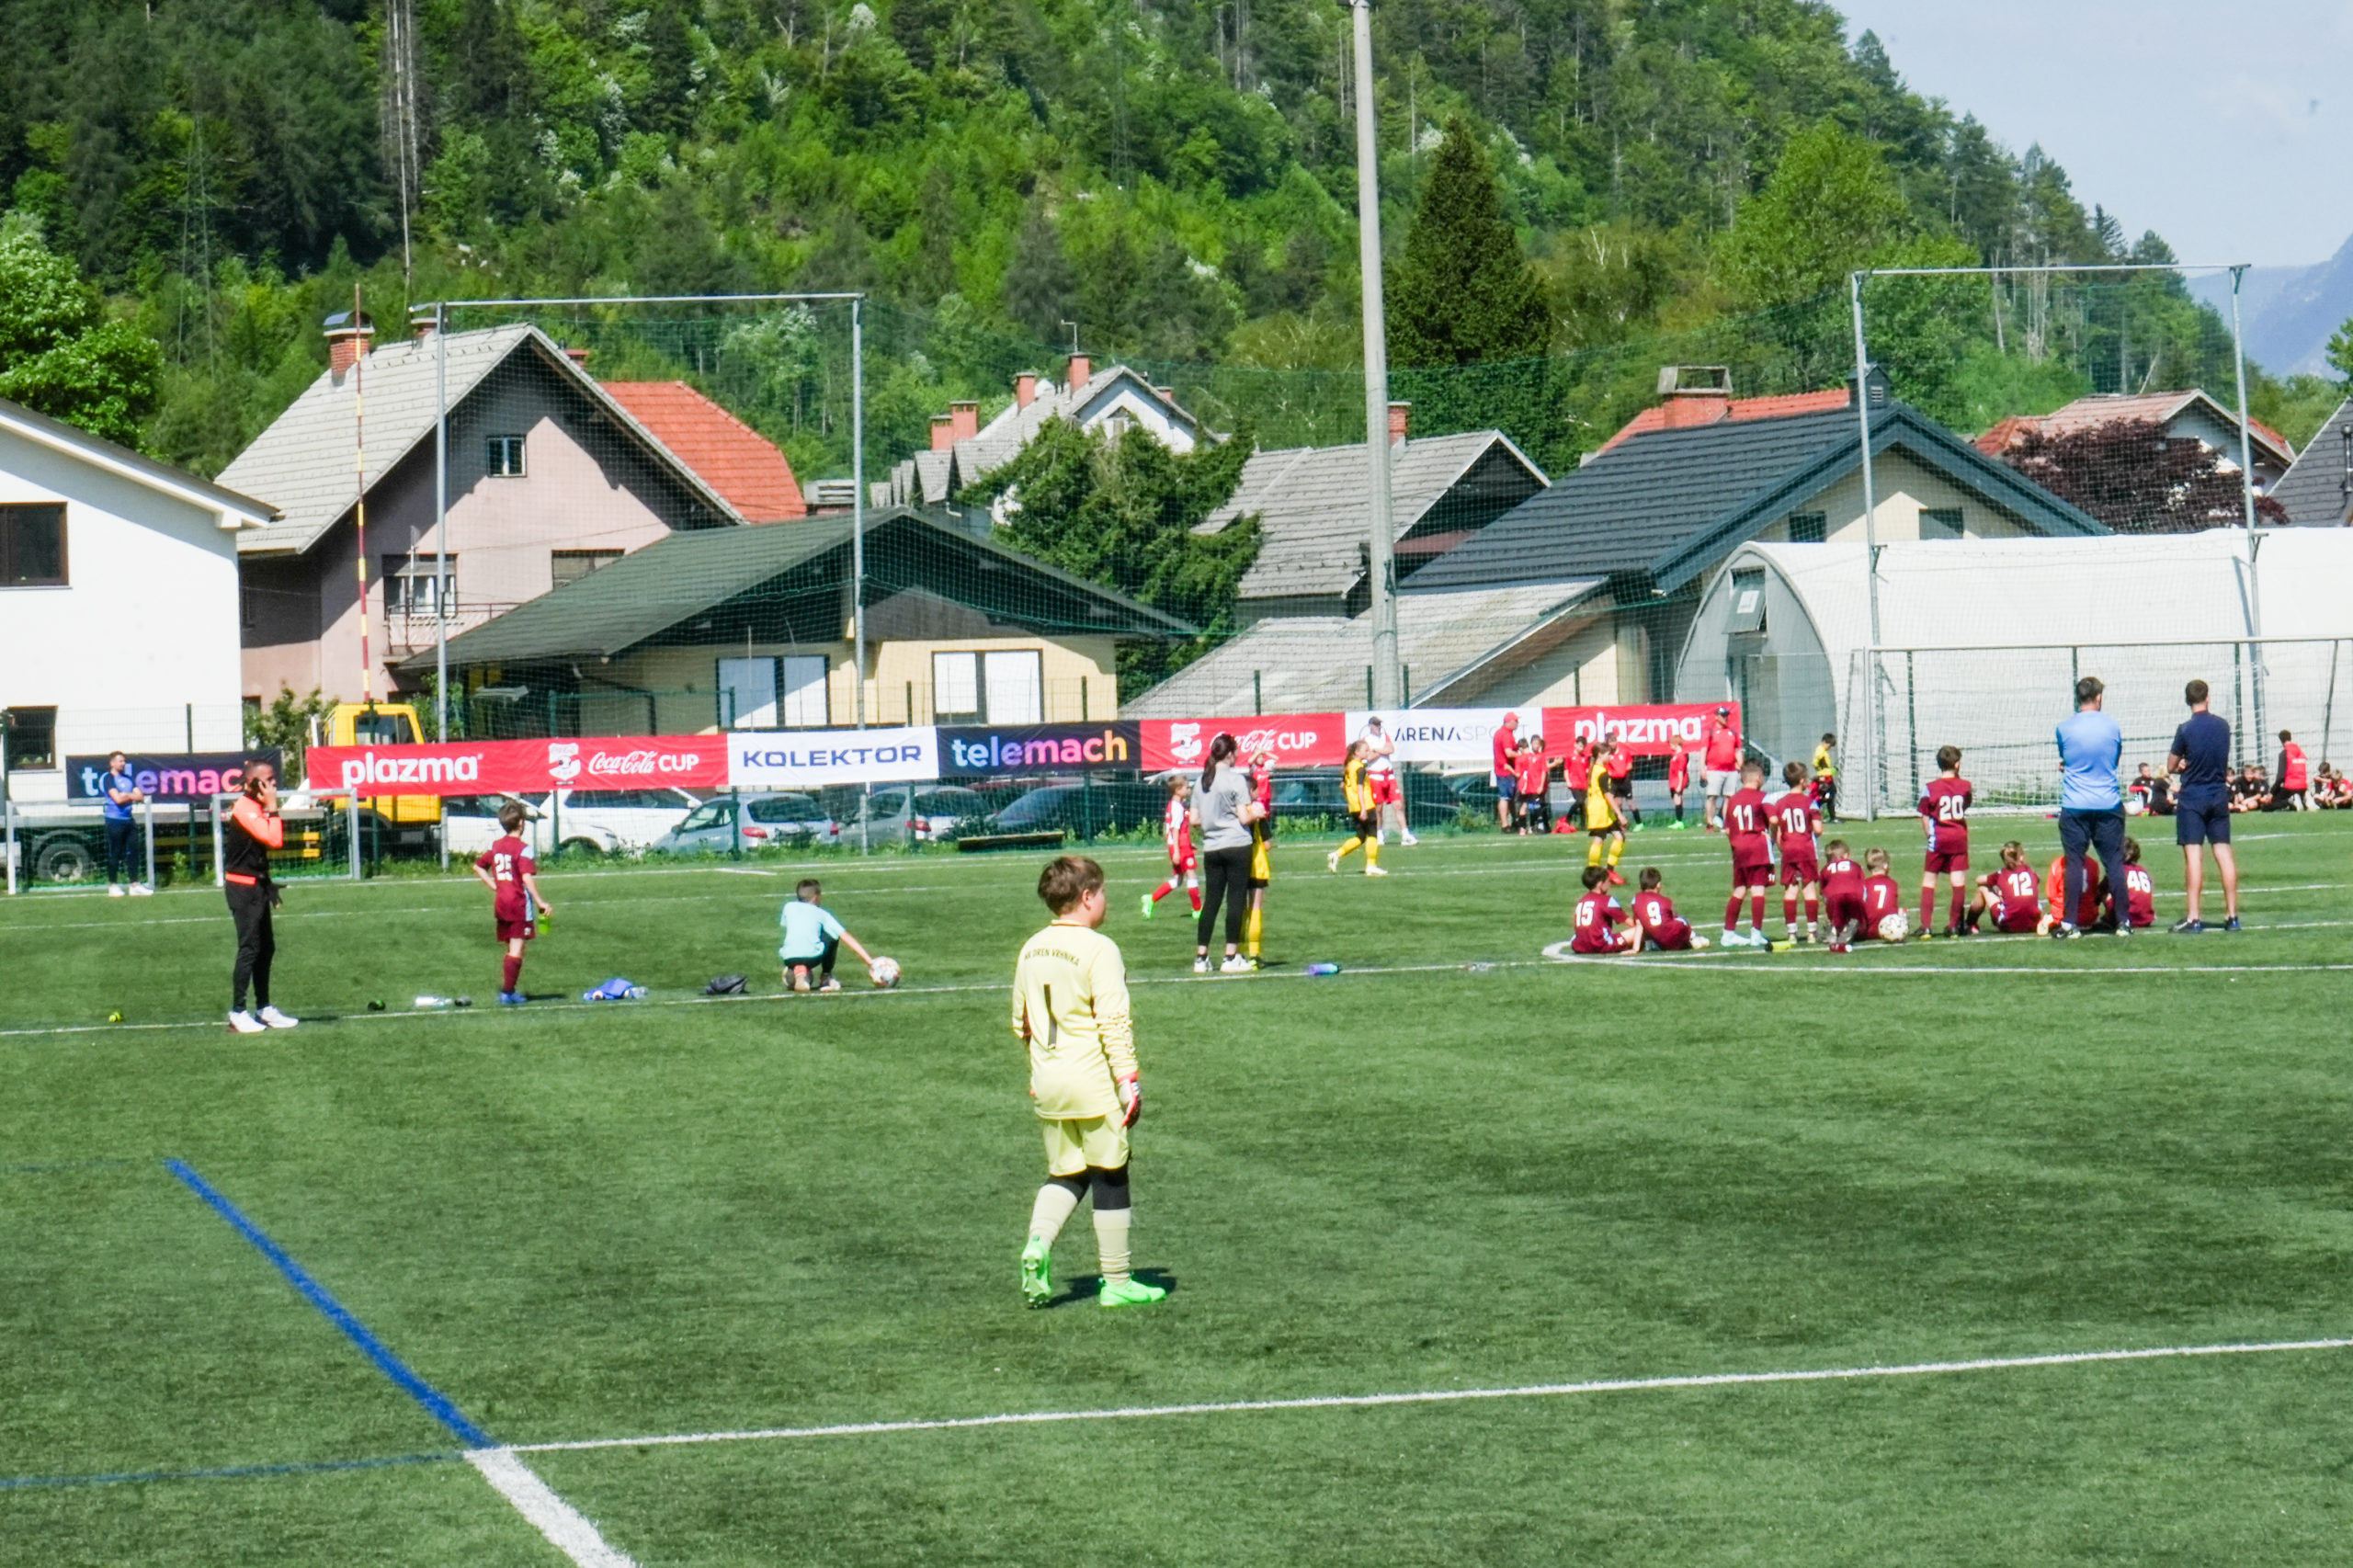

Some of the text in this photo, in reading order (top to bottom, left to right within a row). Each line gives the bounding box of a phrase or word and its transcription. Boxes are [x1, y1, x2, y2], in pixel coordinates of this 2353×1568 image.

[1395, 727, 1461, 742] ARENA
[1574, 712, 1702, 743] plazma
[951, 731, 1128, 767] telemach
[1278, 732, 1317, 750] CUP
[658, 754, 699, 772] CUP
[743, 745, 922, 767] KOLEKTOR
[342, 752, 478, 789] plazma
[1733, 804, 1754, 831] 11
[1939, 795, 1964, 821] 20
[1781, 808, 1807, 834] 10
[2007, 871, 2034, 896] 12
[2127, 869, 2152, 893] 46
[1873, 884, 1887, 909] 7
[1575, 901, 1596, 926] 15
[1647, 901, 1662, 926] 9
[1043, 983, 1057, 1050] 1
